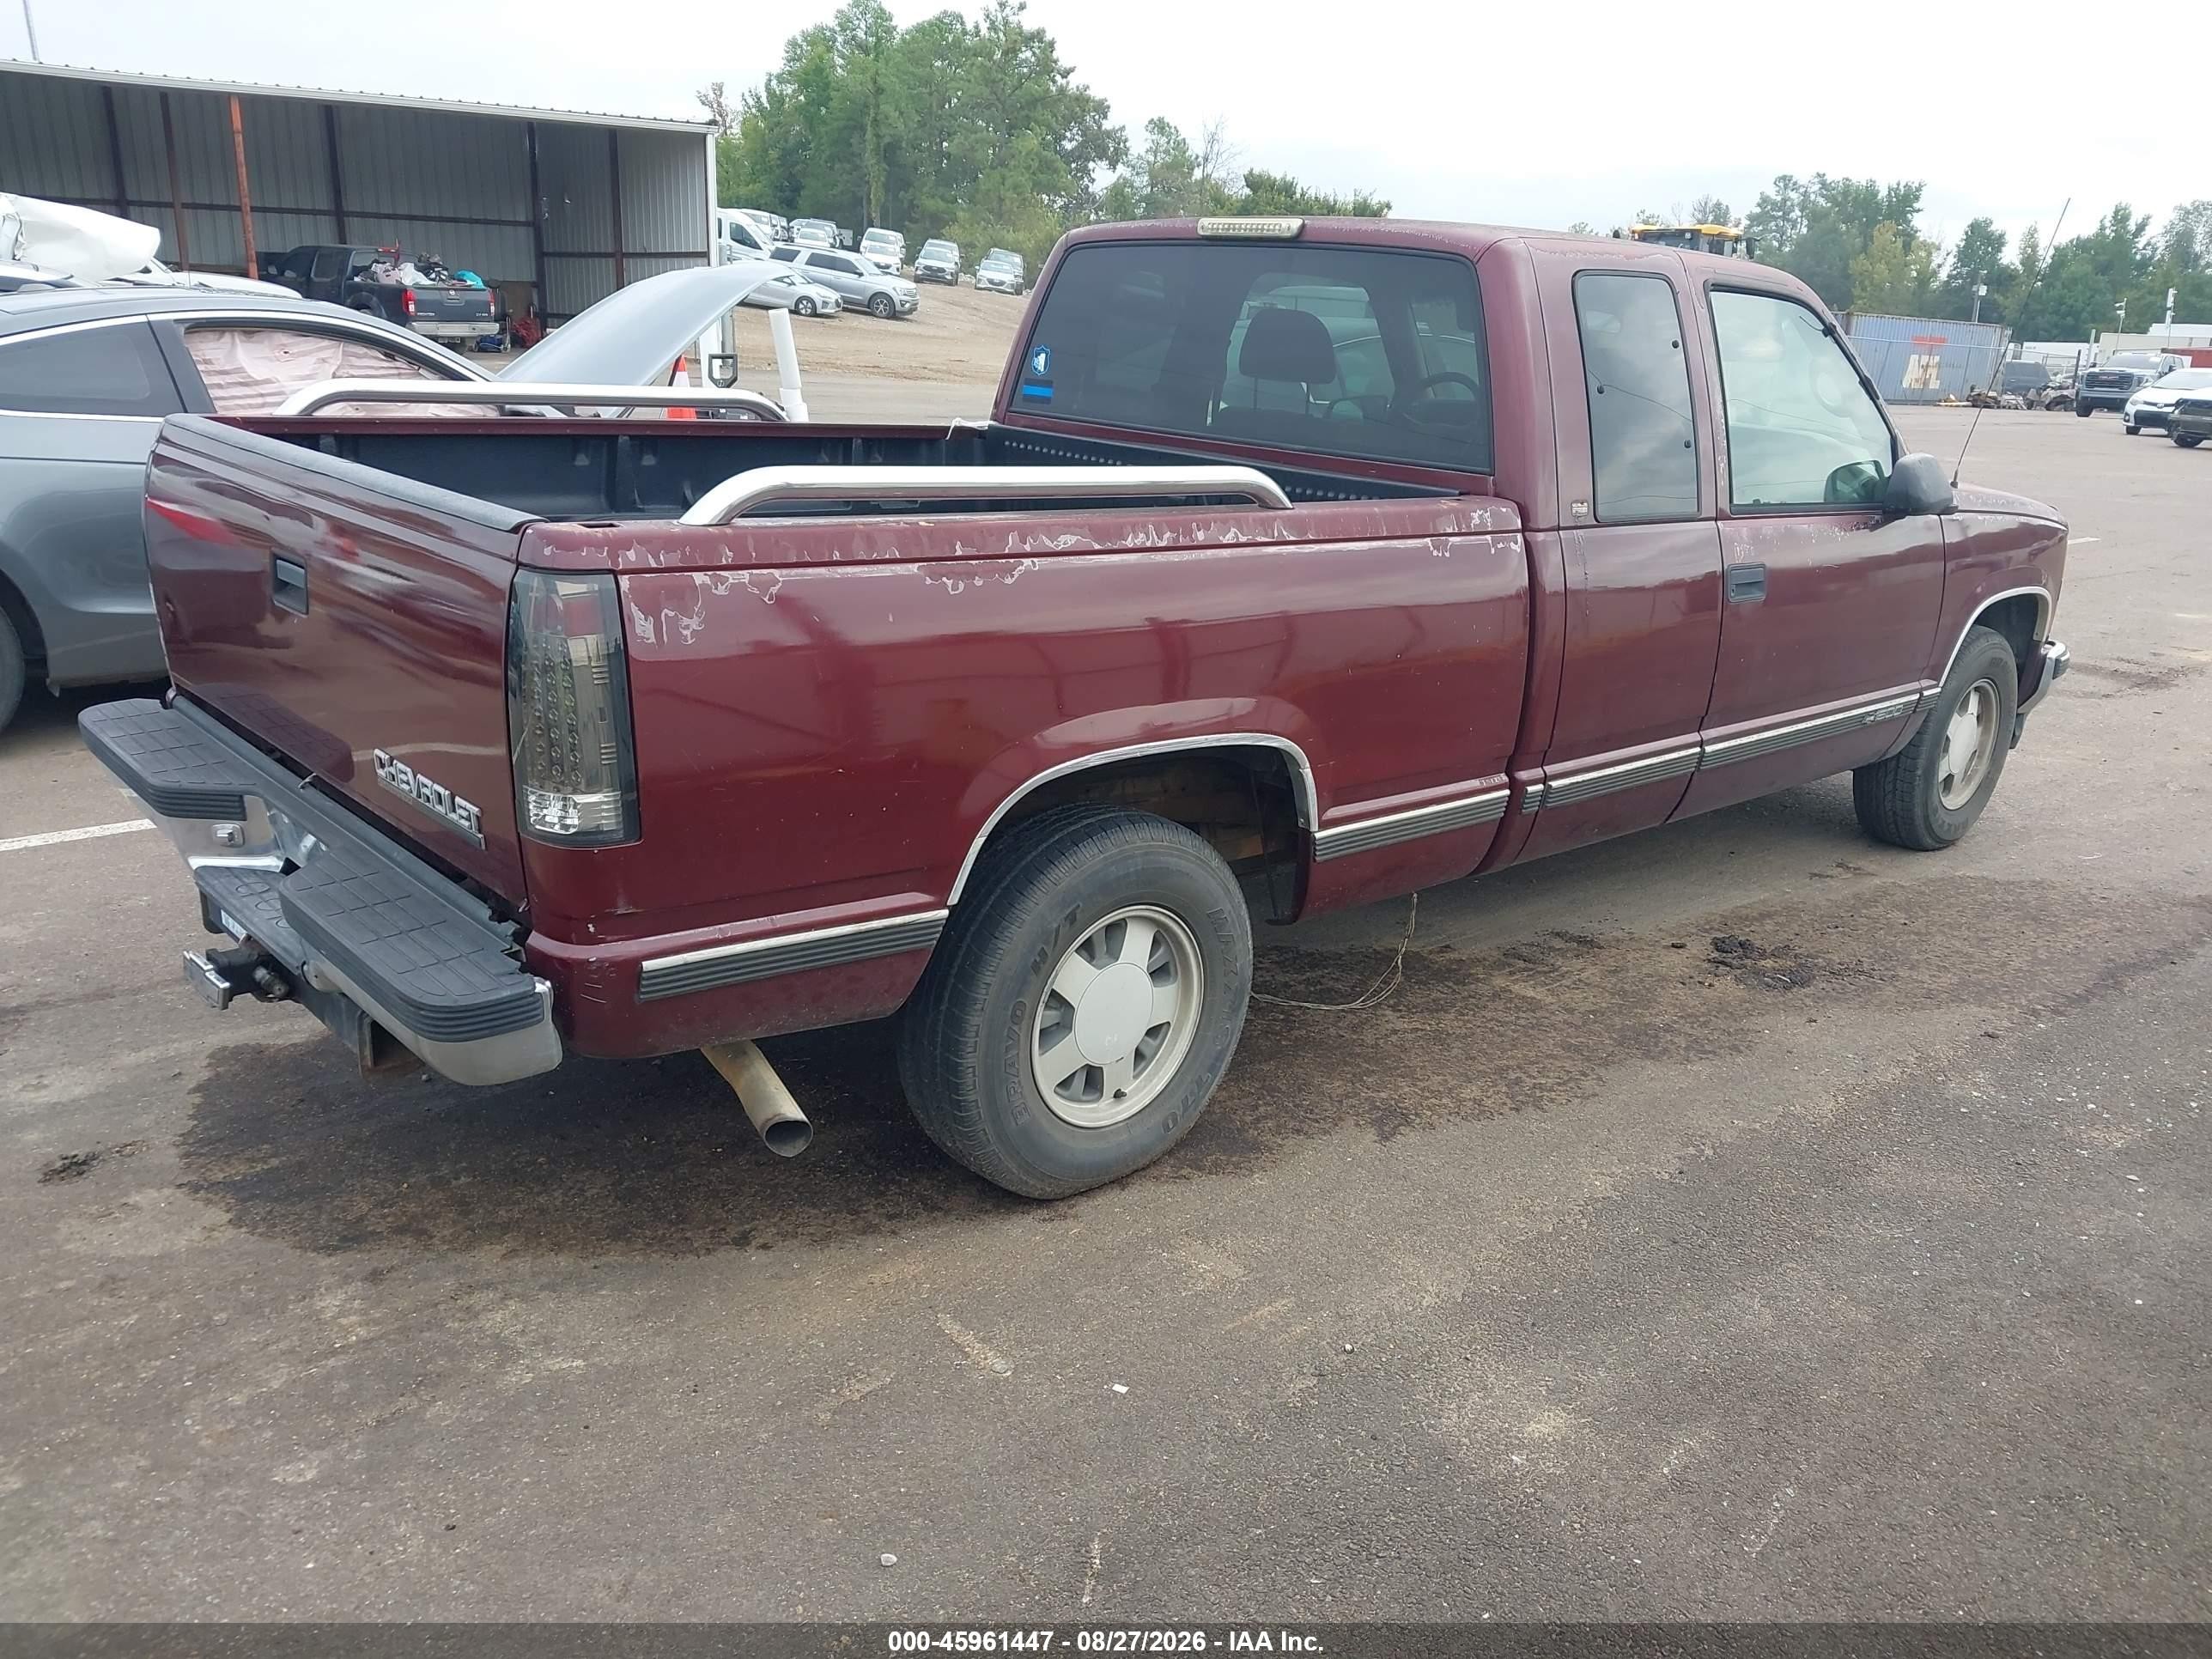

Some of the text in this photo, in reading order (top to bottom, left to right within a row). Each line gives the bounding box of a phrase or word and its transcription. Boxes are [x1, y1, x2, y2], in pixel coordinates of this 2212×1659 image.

[374, 748, 482, 835] CHEVROLET
[1003, 902, 1082, 1127] BRAVO H/T
